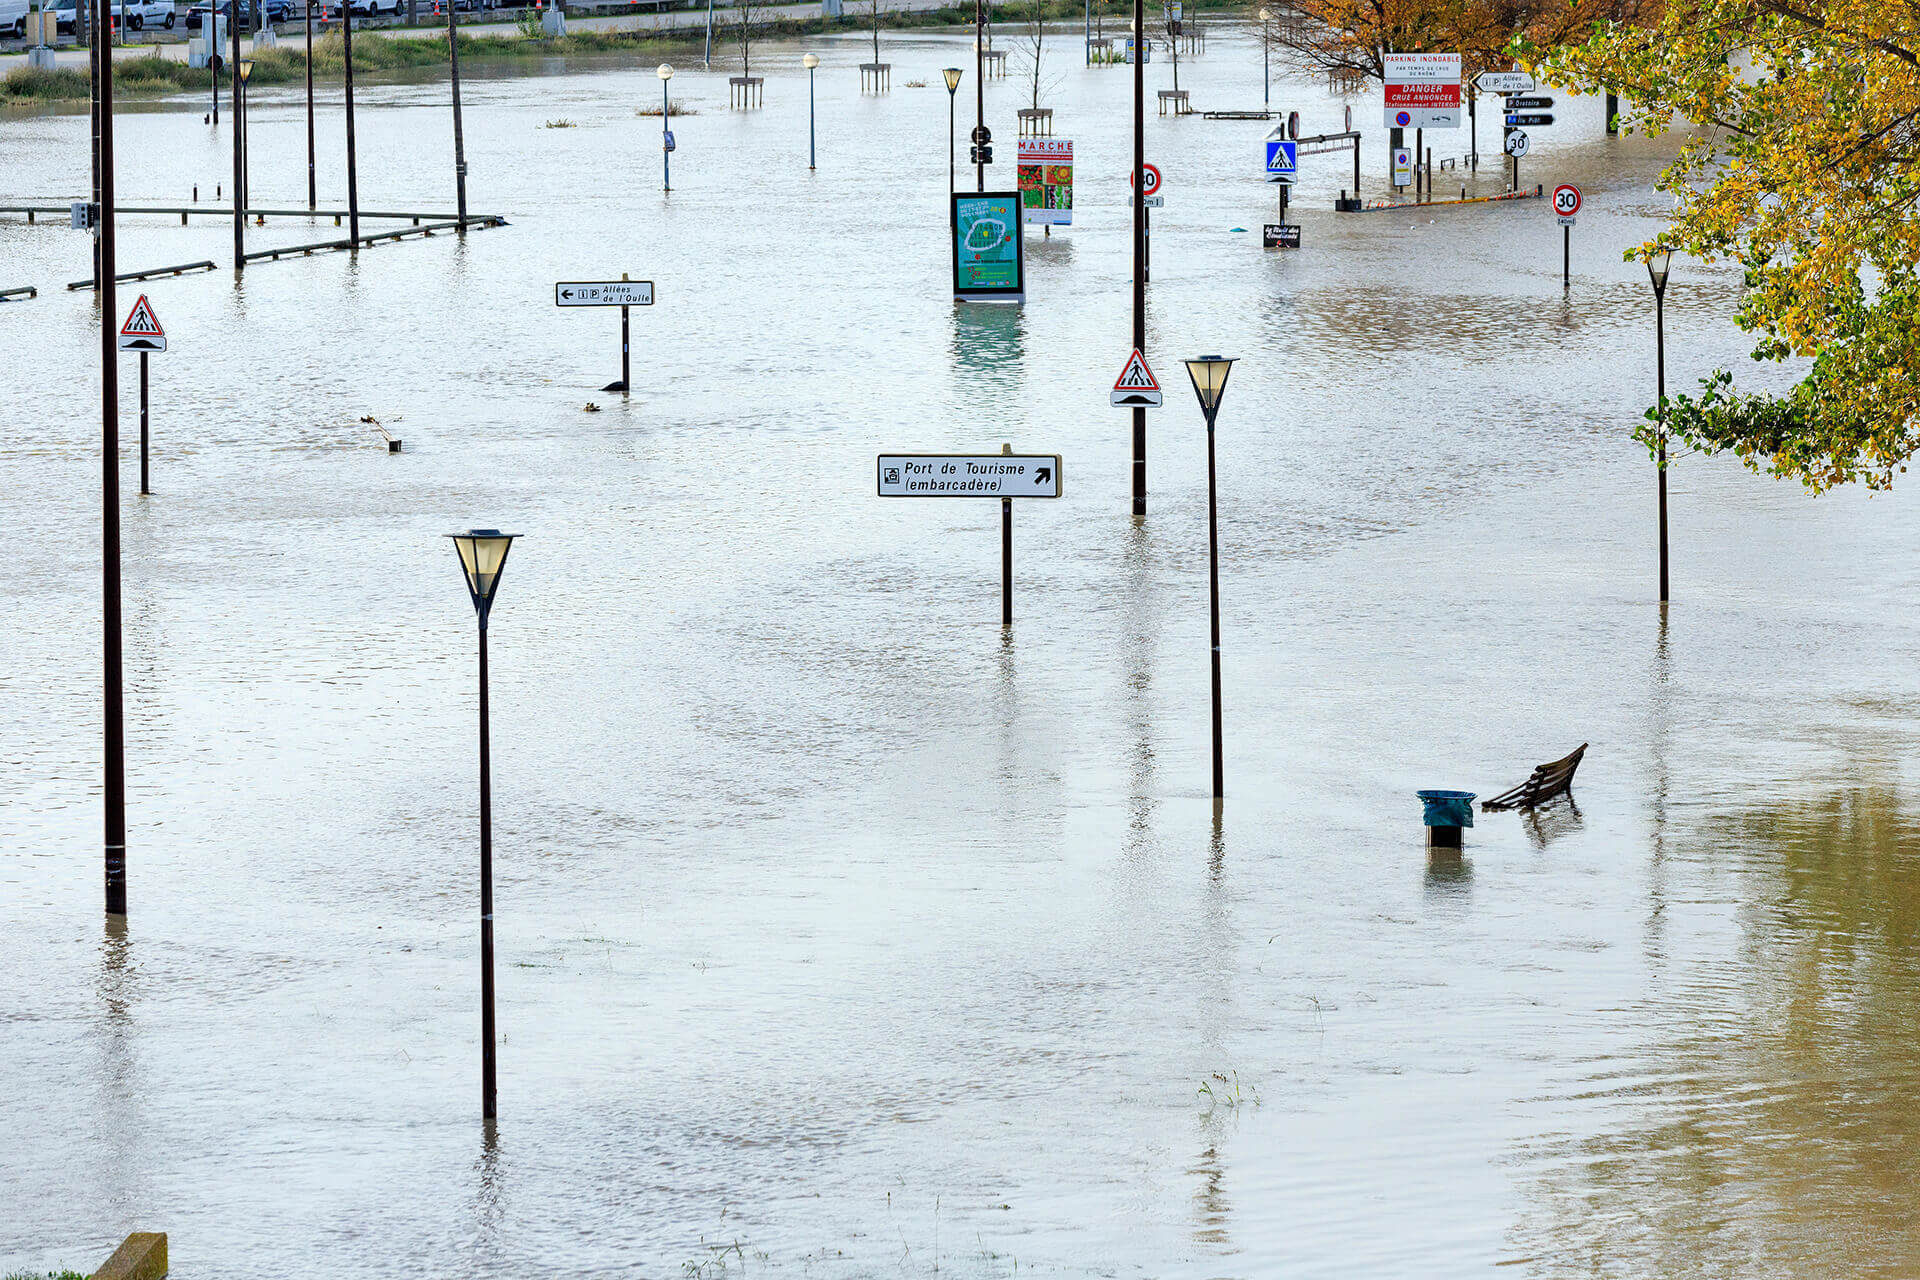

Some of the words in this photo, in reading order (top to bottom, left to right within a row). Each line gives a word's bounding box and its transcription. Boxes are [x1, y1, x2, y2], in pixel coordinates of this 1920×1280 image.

[1402, 85, 1443, 93] DANGER
[1511, 138, 1525, 149] 30
[1557, 193, 1576, 207] 30
[602, 285, 631, 294] Allées
[904, 463, 932, 474] Port
[941, 463, 957, 474] de
[966, 463, 1025, 474] Tourisme
[905, 477, 1002, 492] (embarcadère)
